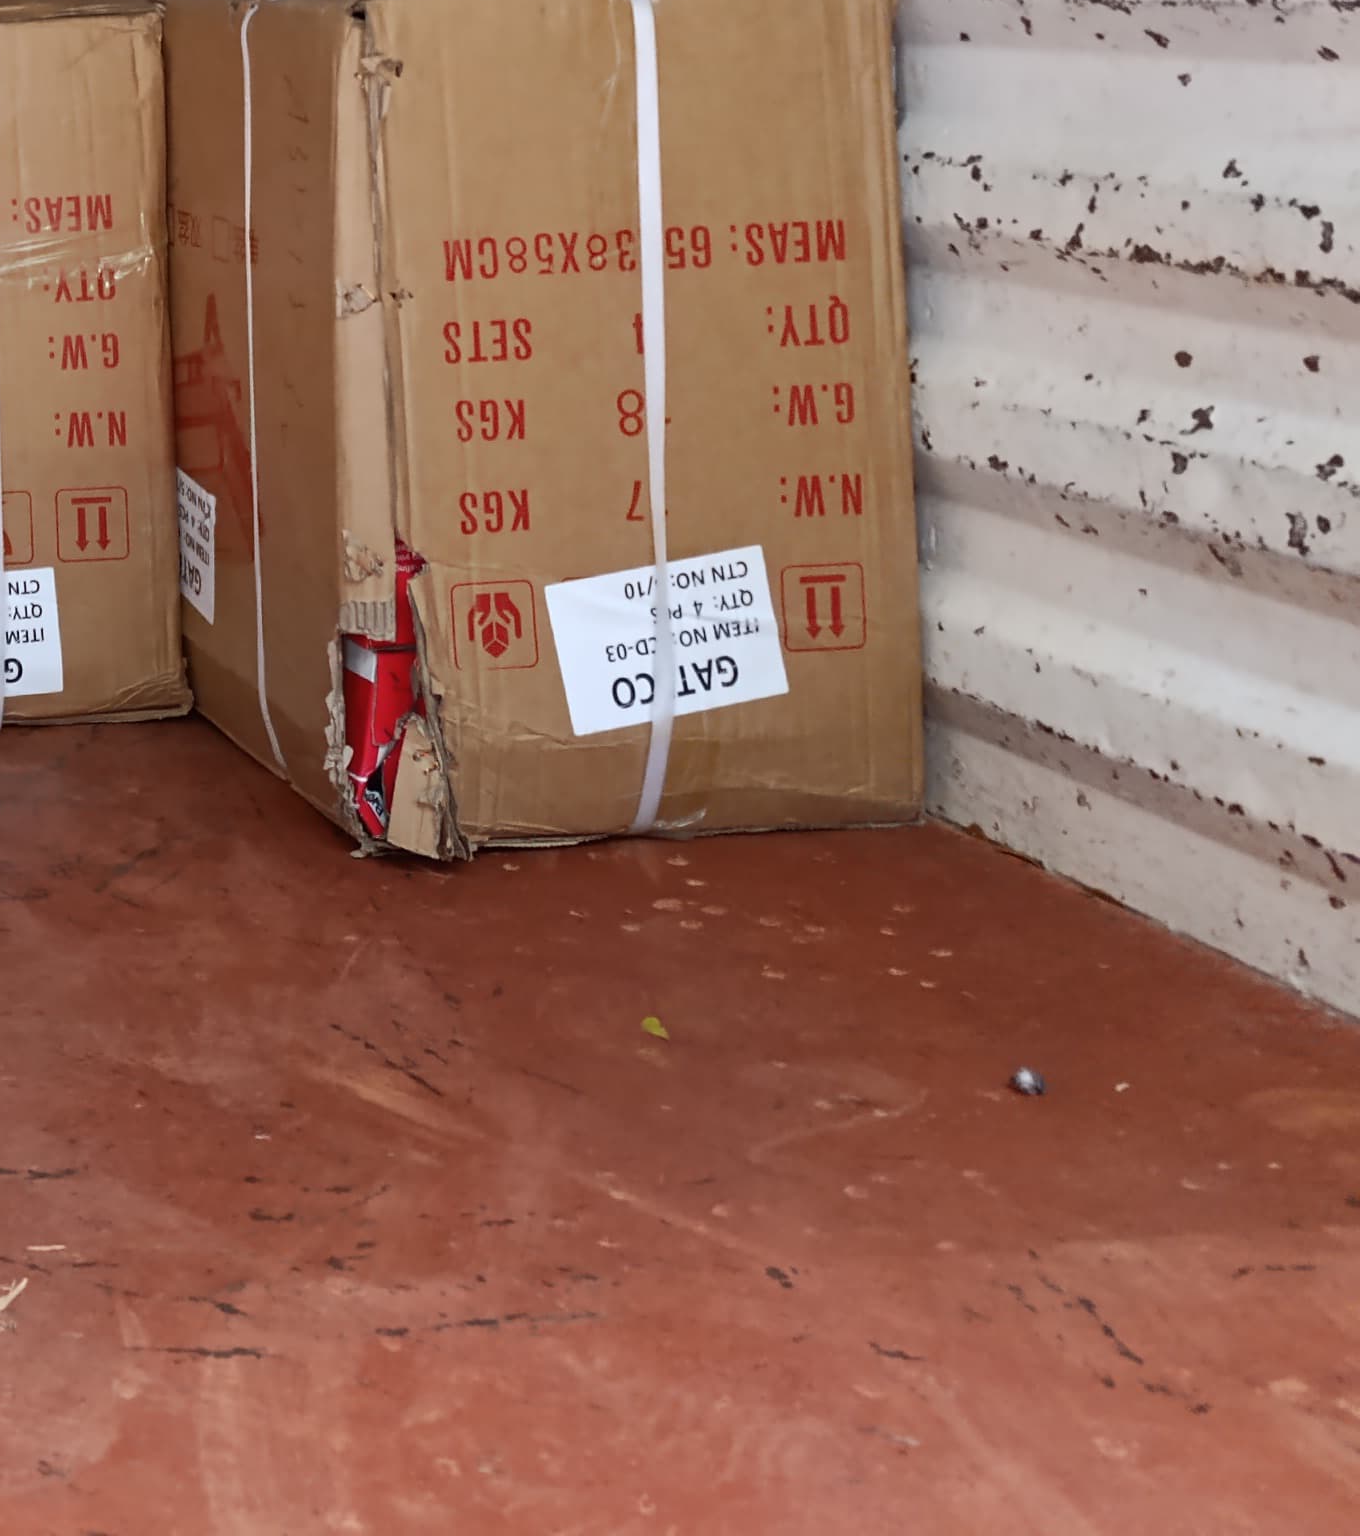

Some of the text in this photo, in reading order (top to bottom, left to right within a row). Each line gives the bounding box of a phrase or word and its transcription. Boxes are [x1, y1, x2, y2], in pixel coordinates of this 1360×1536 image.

[12, 195, 113, 232] MEAS:
[444, 220, 846, 282] MEAS: 6538X58CM
[443, 295, 849, 364] QTY: SETS
[49, 333, 119, 369] G.W:
[56, 411, 127, 447] N.W:
[456, 383, 854, 442] G.W: 8 KGS
[460, 489, 529, 535] KGS
[780, 474, 862, 517] N.W:
[7, 580, 40, 595] CTN
[624, 561, 748, 600] CTN NO: /10
[8, 602, 42, 619] QTY:
[693, 600, 703, 616] 4
[713, 589, 753, 611] QTY:
[5, 628, 44, 645] ITEM
[672, 626, 707, 648] NO:
[713, 618, 759, 639] ITEM
[612, 655, 739, 709] GATCO
